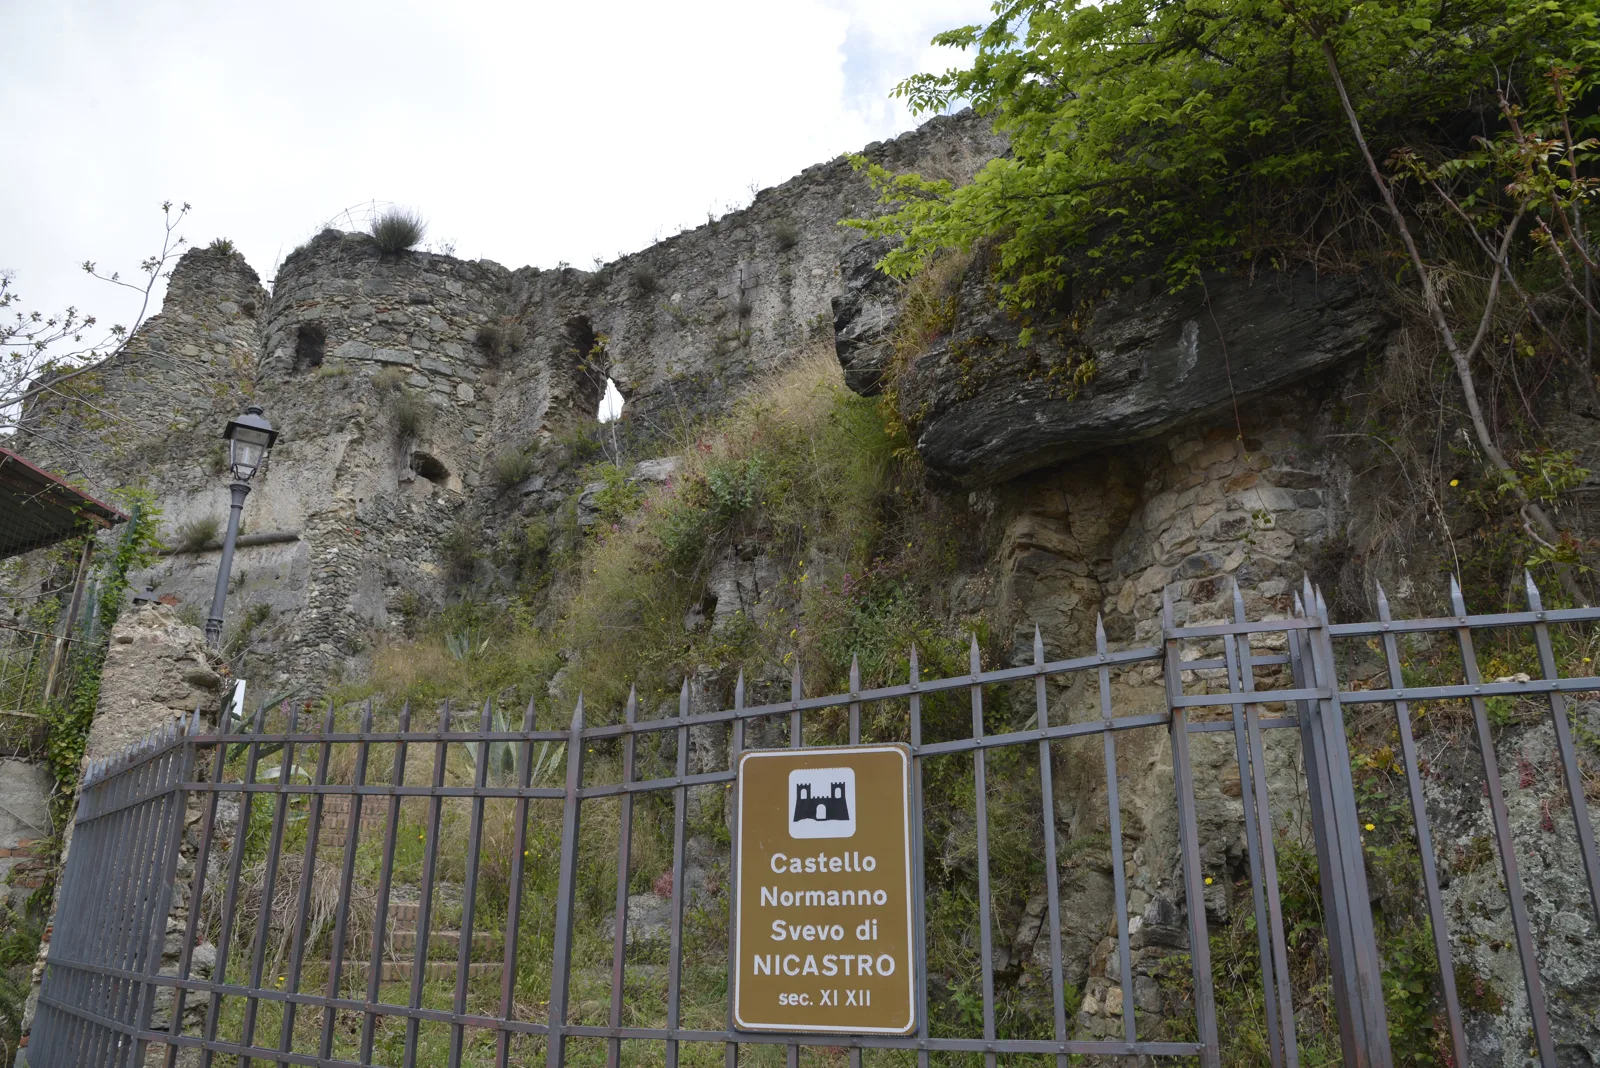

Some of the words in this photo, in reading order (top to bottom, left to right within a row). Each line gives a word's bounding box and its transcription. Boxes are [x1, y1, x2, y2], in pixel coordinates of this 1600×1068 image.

[770, 851, 877, 874] Castello
[760, 885, 888, 907] Normanno
[770, 919, 845, 942] Svevo
[855, 918, 878, 941] di
[753, 953, 896, 977] NICASTRO
[778, 992, 814, 1006] sec.
[819, 989, 838, 1006] XI
[845, 989, 871, 1007] XII
